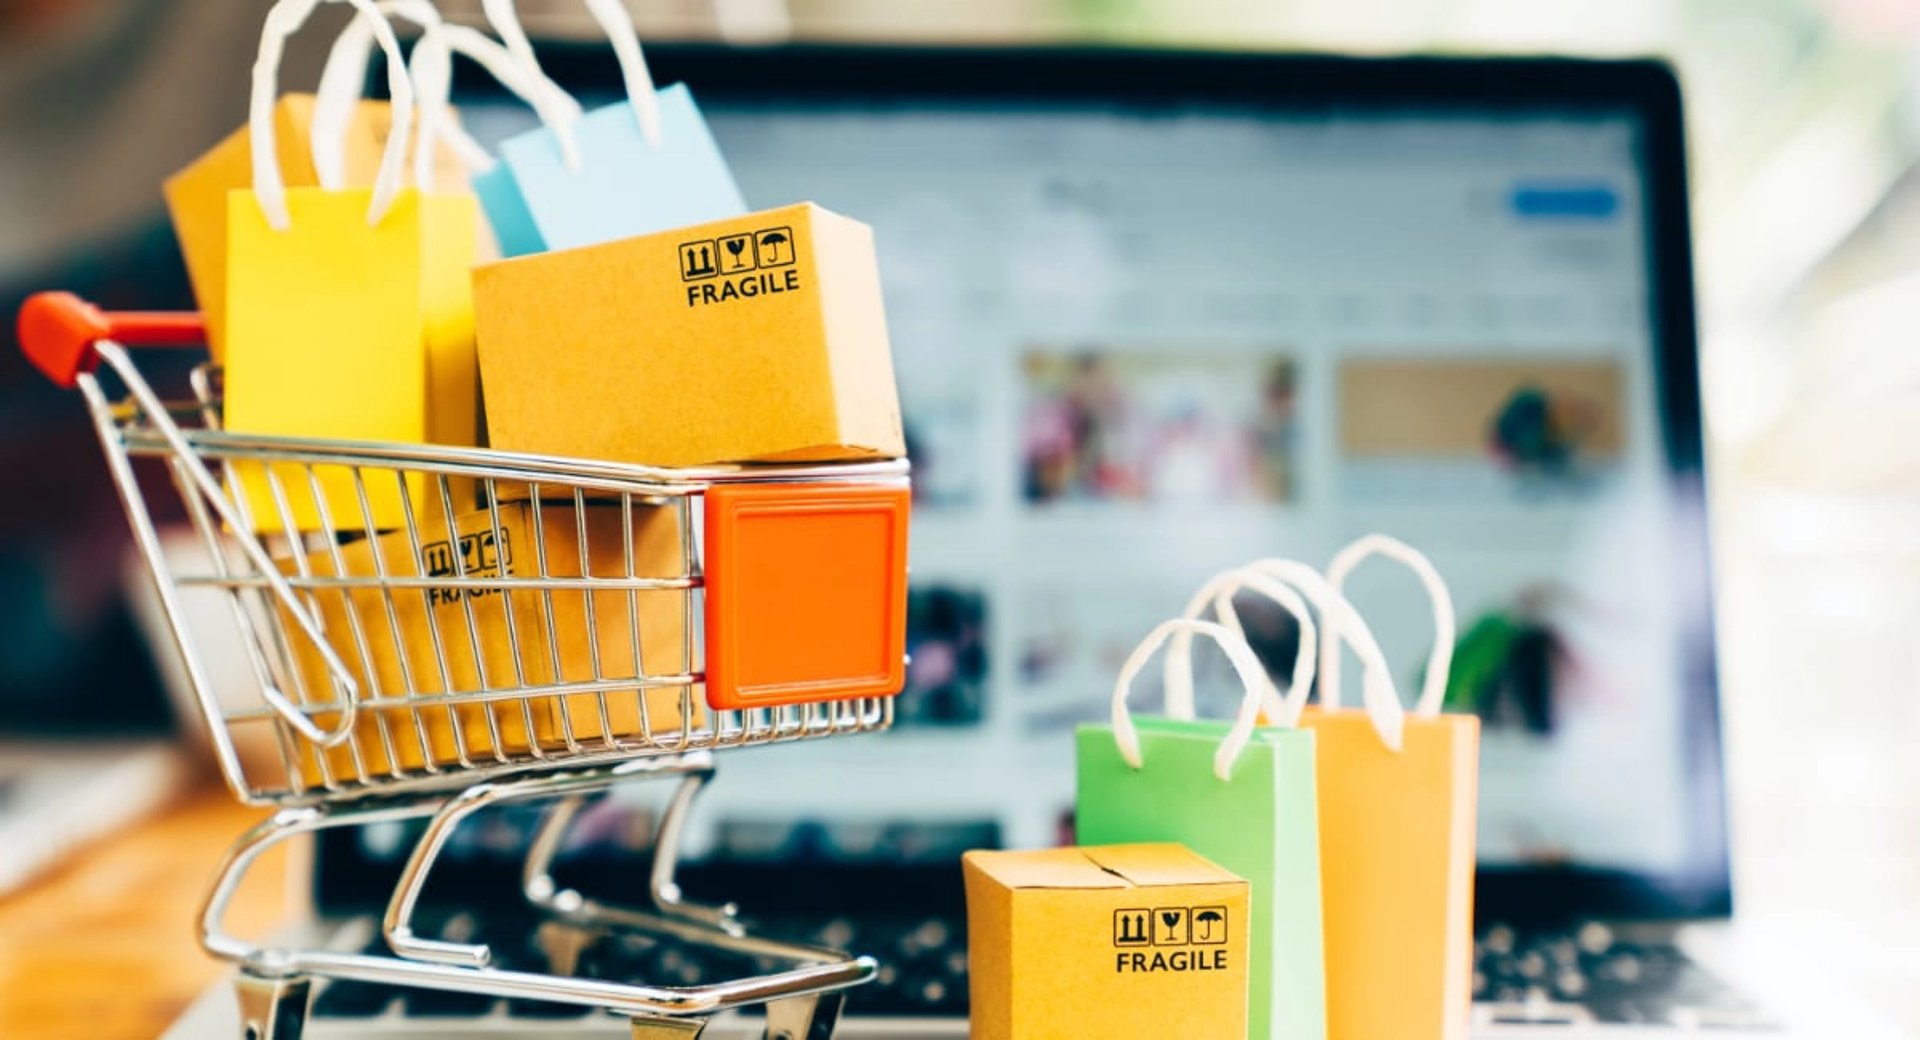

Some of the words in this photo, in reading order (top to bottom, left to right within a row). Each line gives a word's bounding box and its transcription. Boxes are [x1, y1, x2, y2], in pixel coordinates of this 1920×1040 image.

[687, 269, 800, 307] FRAGILE
[427, 570, 514, 607] FRGL
[1116, 950, 1227, 973] FRAGILE
